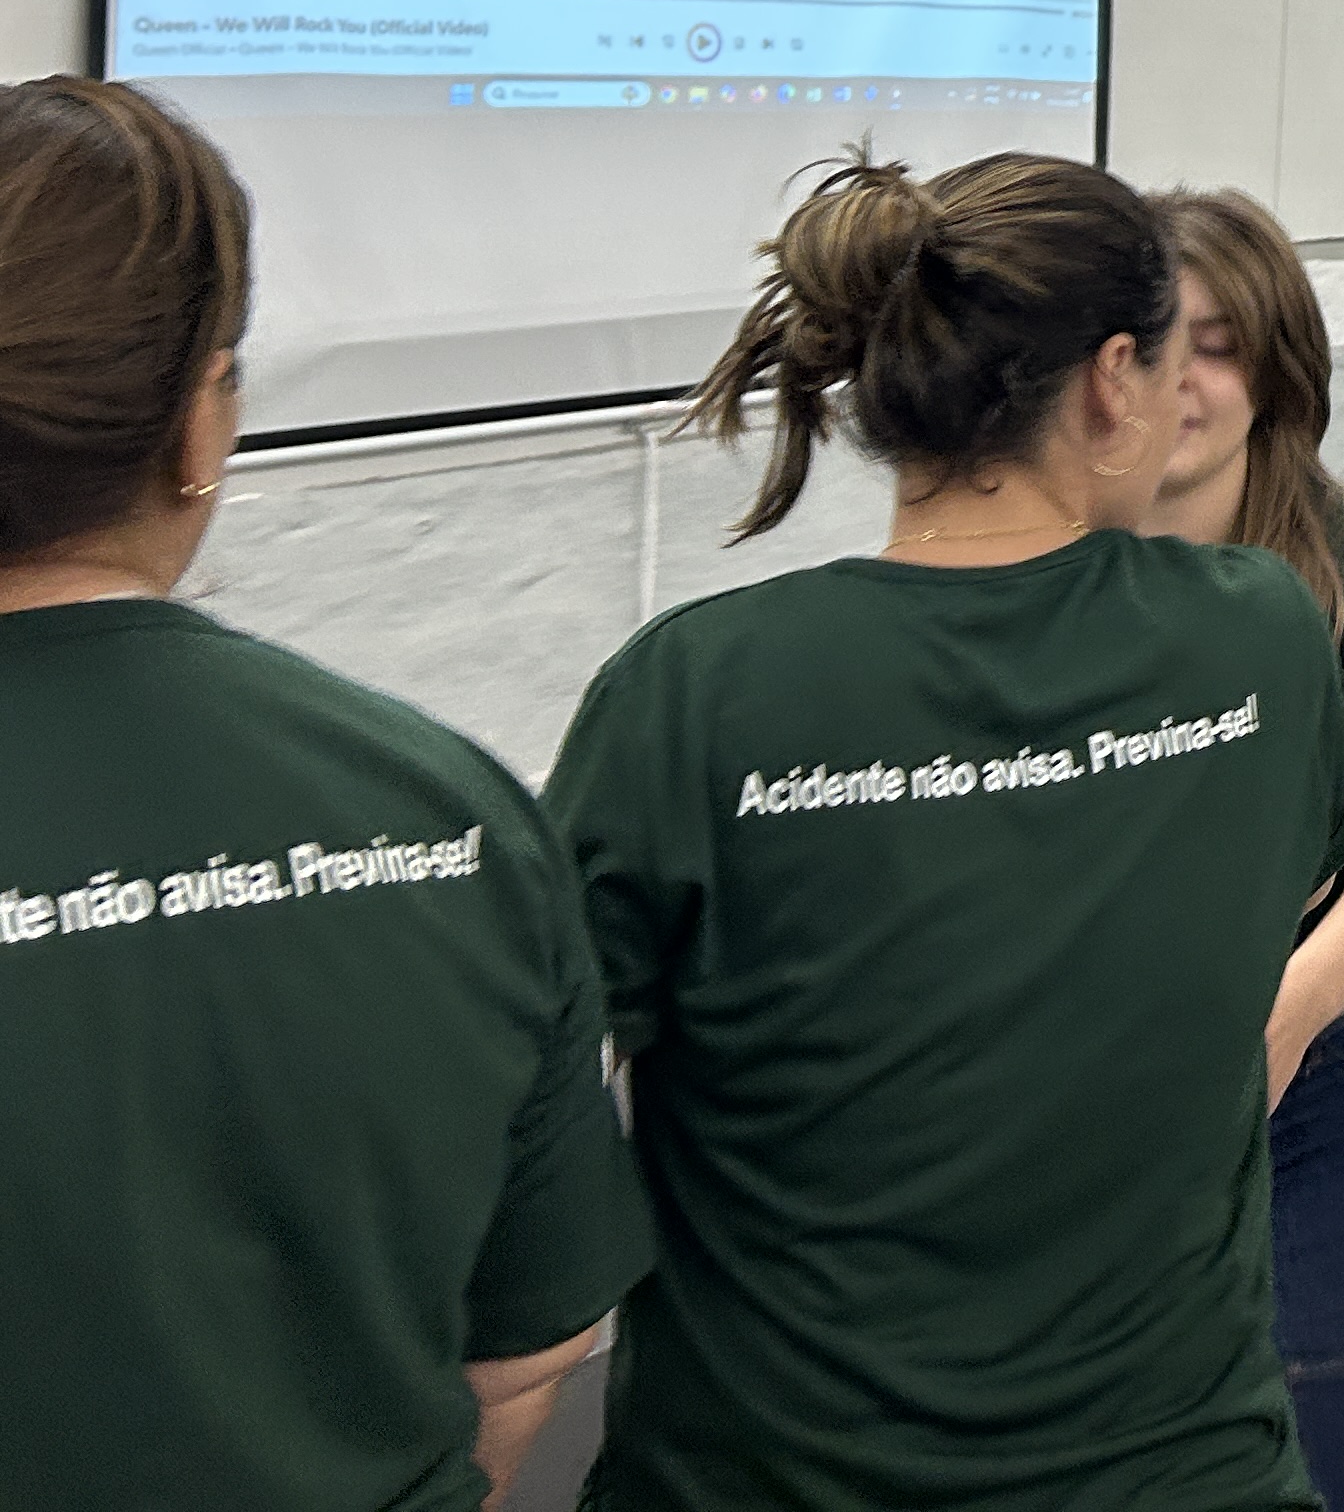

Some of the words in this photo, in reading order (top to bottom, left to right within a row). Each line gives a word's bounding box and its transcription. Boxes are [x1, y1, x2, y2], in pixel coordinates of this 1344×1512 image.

[134, 16, 197, 33] Queen
[215, 16, 247, 33] We
[295, 15, 333, 33] Rock
[336, 18, 366, 34] You
[736, 759, 907, 818] Acidente
[909, 753, 978, 801] não
[982, 745, 1086, 794] avisa.
[1087, 692, 1261, 775] Previna-se!
[57, 868, 157, 935] não
[158, 851, 292, 917] avisa.
